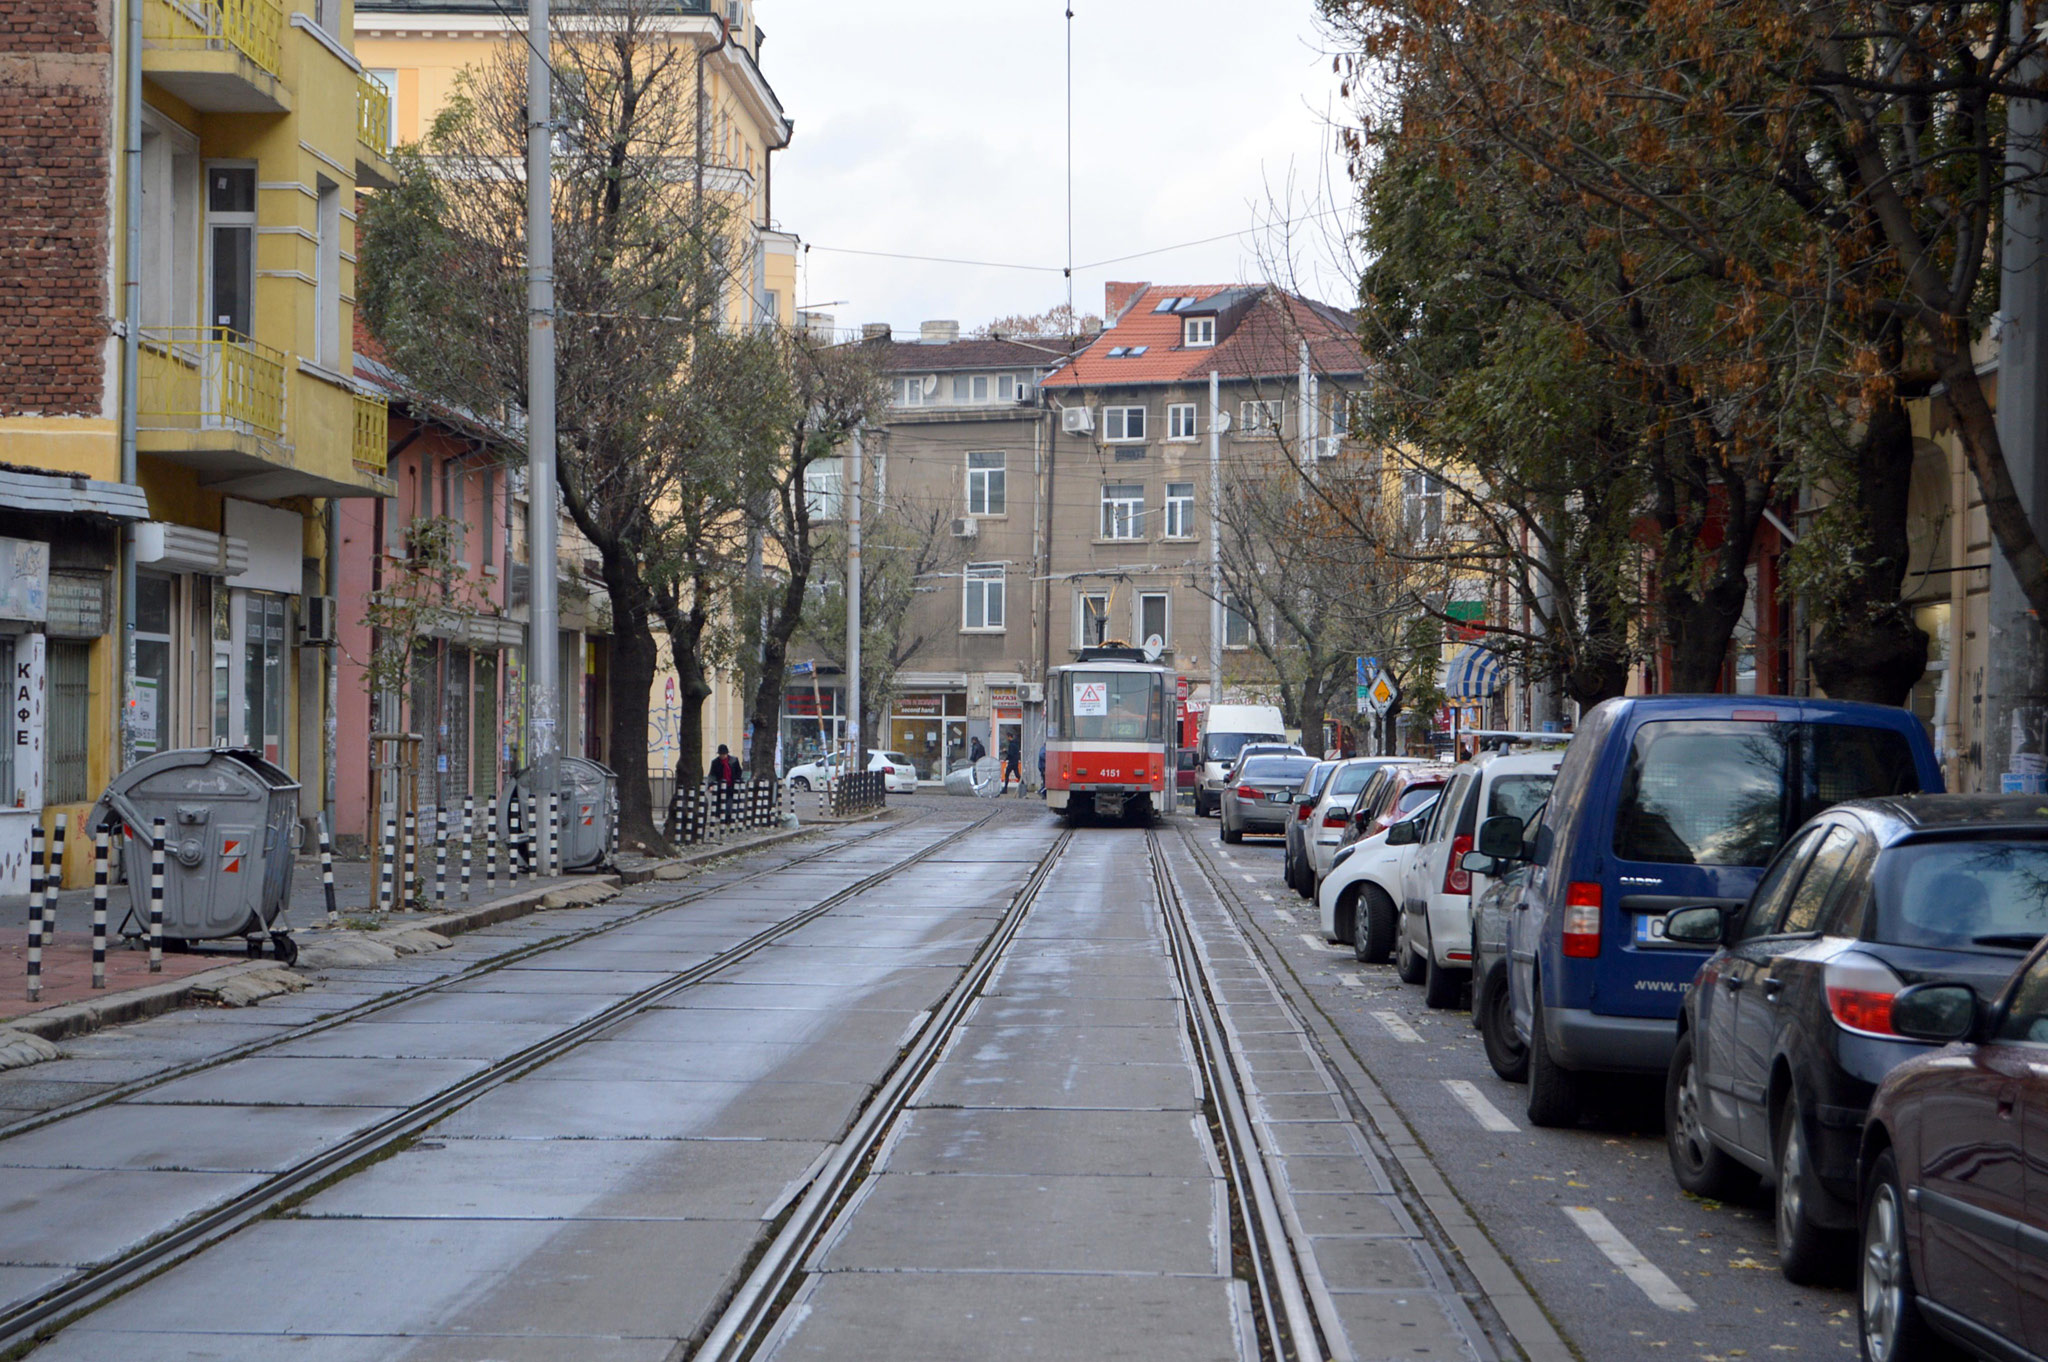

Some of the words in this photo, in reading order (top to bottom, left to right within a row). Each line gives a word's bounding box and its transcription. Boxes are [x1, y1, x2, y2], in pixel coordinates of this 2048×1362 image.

[17, 662, 31, 746] КАФЕ
[1099, 768, 1121, 778] 4151
[1620, 876, 1662, 886] CADDY
